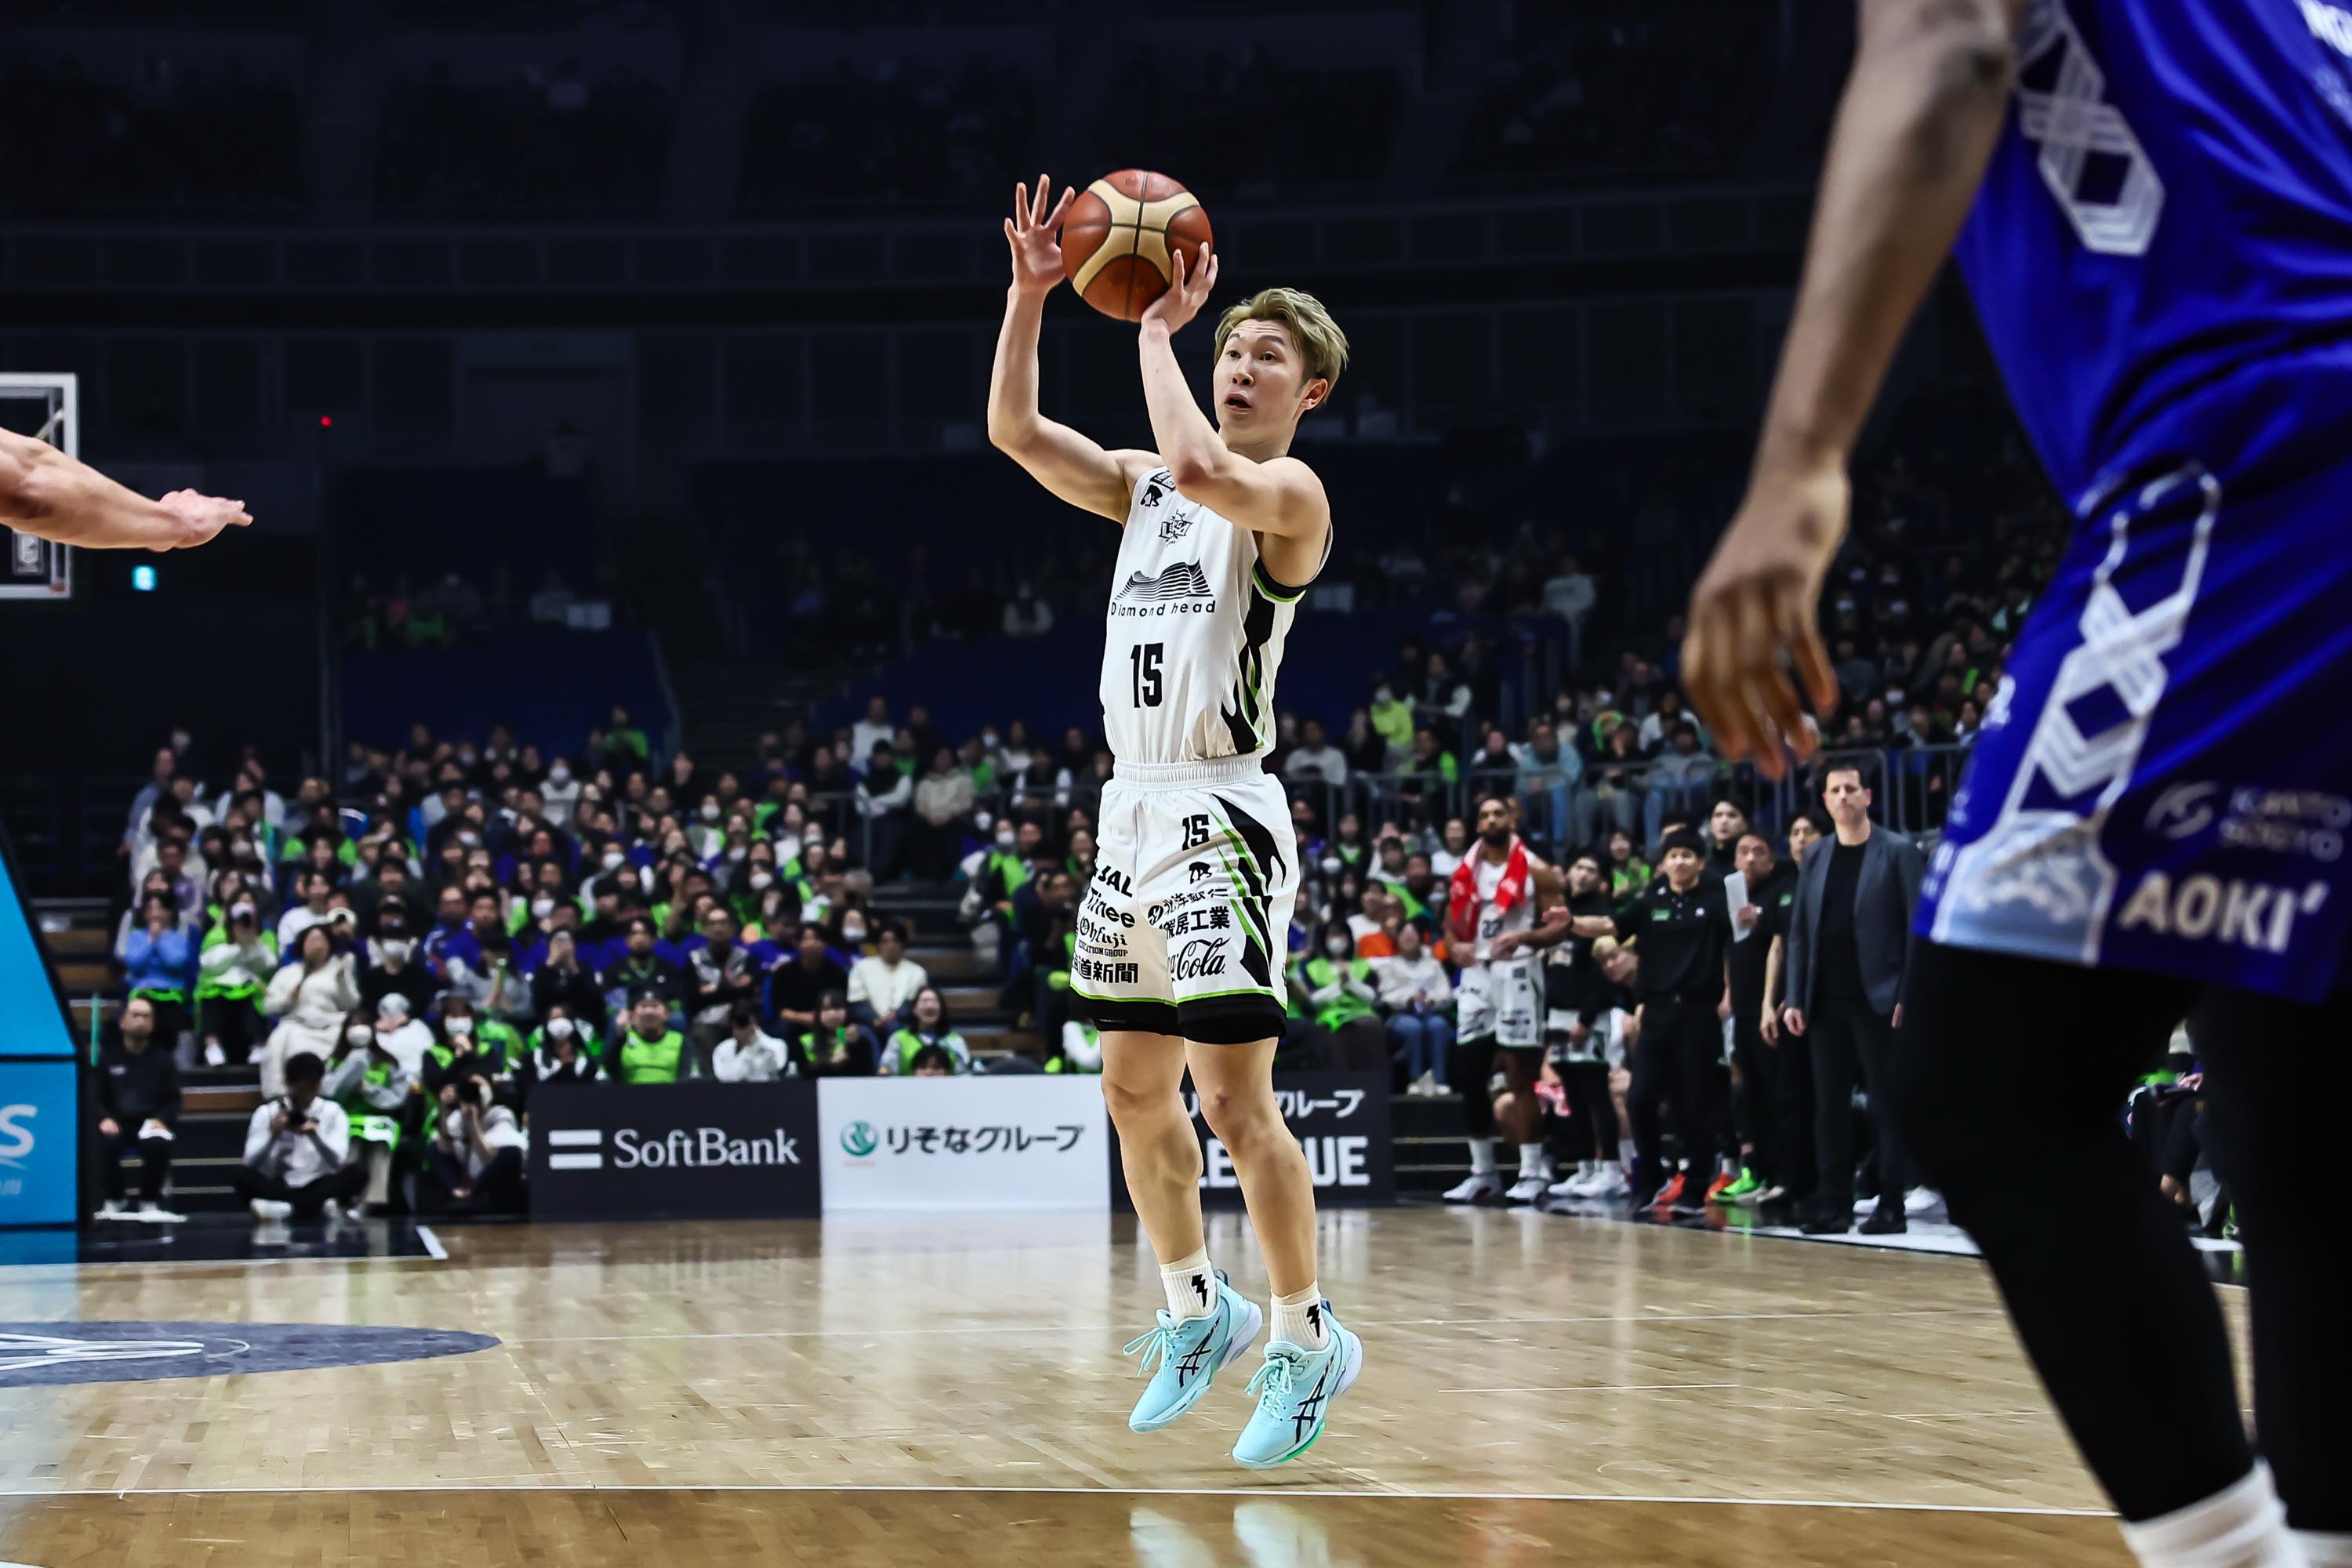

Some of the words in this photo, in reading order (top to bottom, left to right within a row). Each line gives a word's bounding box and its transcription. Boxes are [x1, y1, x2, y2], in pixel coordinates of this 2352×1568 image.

[1111, 602, 1166, 617] Diamond
[1171, 600, 1216, 615] head
[1131, 642, 1164, 708] 15
[1181, 814, 1210, 851] 15
[613, 1127, 801, 1169] SoftBank
